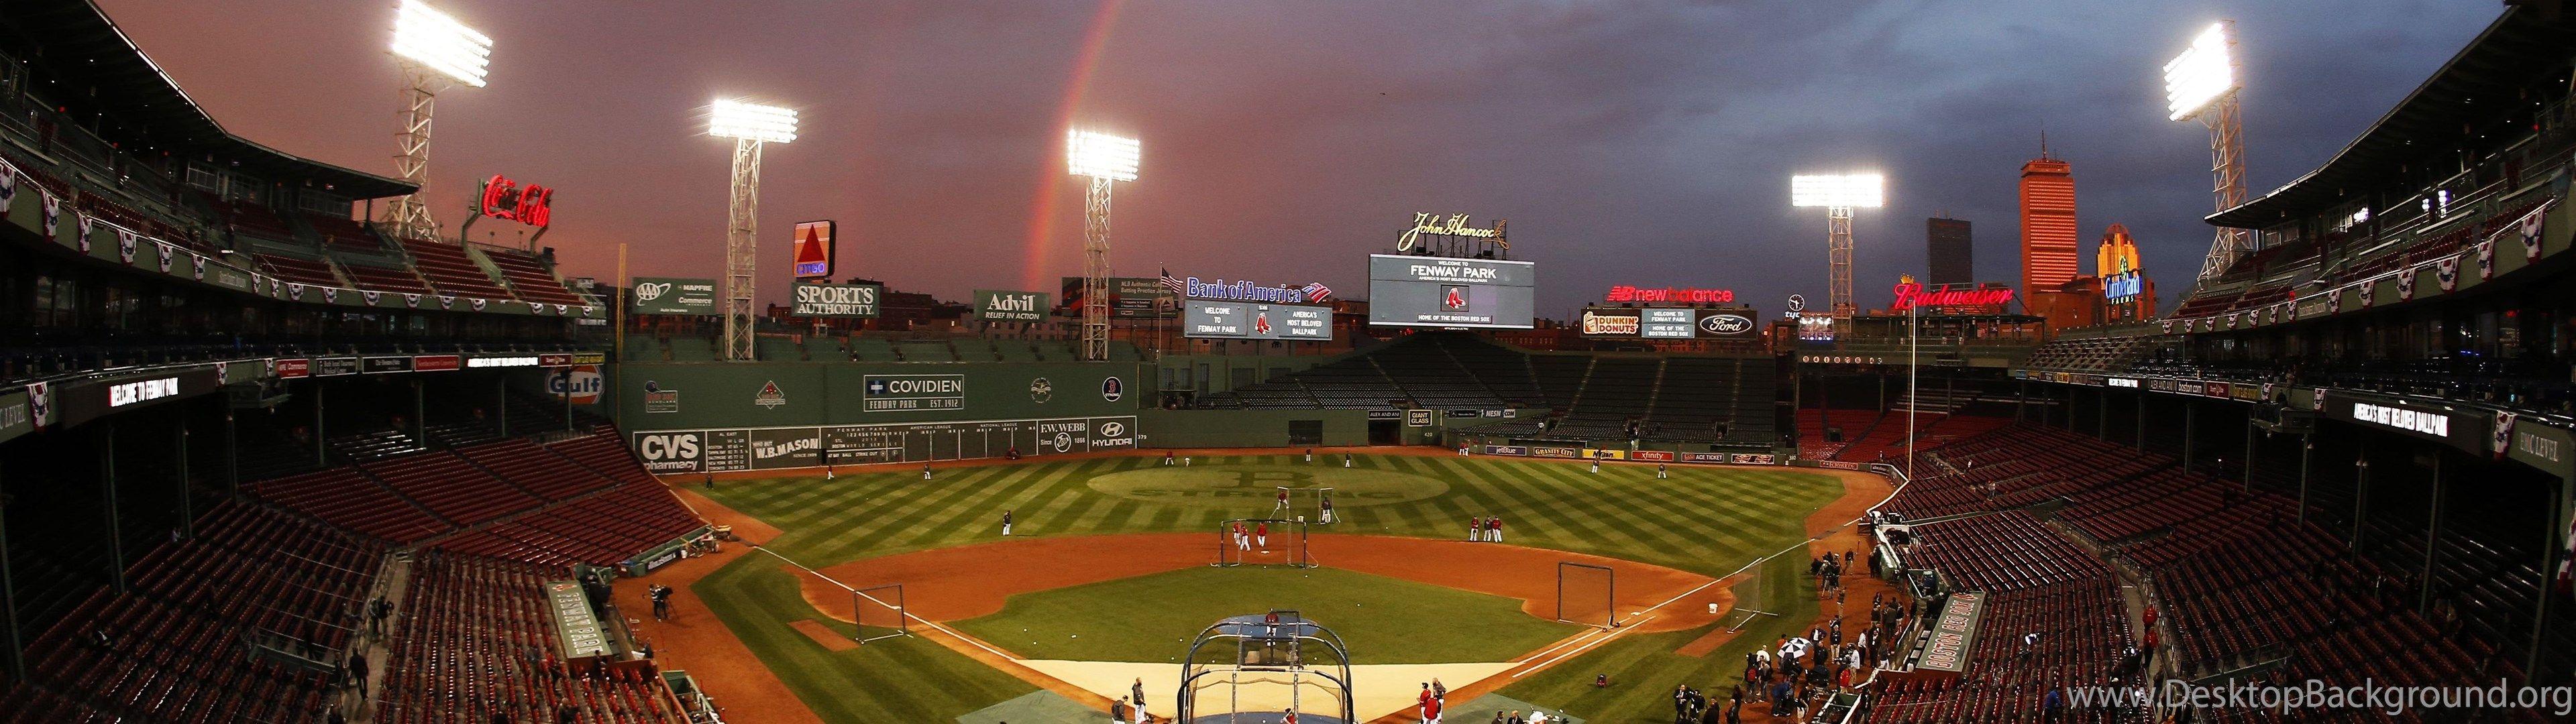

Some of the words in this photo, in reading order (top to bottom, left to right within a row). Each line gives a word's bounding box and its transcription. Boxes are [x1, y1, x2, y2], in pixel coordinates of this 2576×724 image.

[1397, 210, 1443, 251] John
[1442, 212, 1509, 249] Hancock
[797, 263, 824, 274] CITGO
[1410, 265, 1460, 278] FENWAY
[1463, 268, 1497, 279] PARK
[797, 286, 873, 304] SPORTS
[1187, 277, 1228, 299] Bank
[1228, 280, 1244, 299] of
[1244, 281, 1301, 302] America
[1894, 282, 2014, 309] Budweiser
[678, 296, 712, 304] Commerce
[987, 294, 1034, 311] Advil
[2111, 296, 2134, 305] FARMS
[1205, 307, 1231, 315] WELCOME
[1599, 316, 1638, 325] DUNKIN'
[1710, 317, 1742, 331] Ford
[1197, 325, 1221, 333] FENWAY
[1222, 326, 1236, 334] PARK
[1599, 324, 1635, 333] DONUTS
[549, 376, 600, 393] Gulf
[890, 380, 961, 394] COVIDIEN
[869, 400, 897, 410] FENWAY
[900, 400, 917, 409] PARK
[930, 400, 943, 408] EST.
[945, 399, 959, 408] 1912
[1059, 423, 1085, 432] WEBB
[642, 434, 699, 460] CVS
[1092, 438, 1132, 447] HYUNDAI
[1560, 448, 1574, 457] CITY
[1641, 452, 1664, 460] xfinity
[643, 460, 698, 470] pharmacy
[557, 592, 592, 627] FENWAY
[1949, 600, 1974, 616] SOX
[1941, 615, 1969, 632] RED
[569, 626, 604, 655] PARK
[1925, 631, 1963, 669] BOSTON
